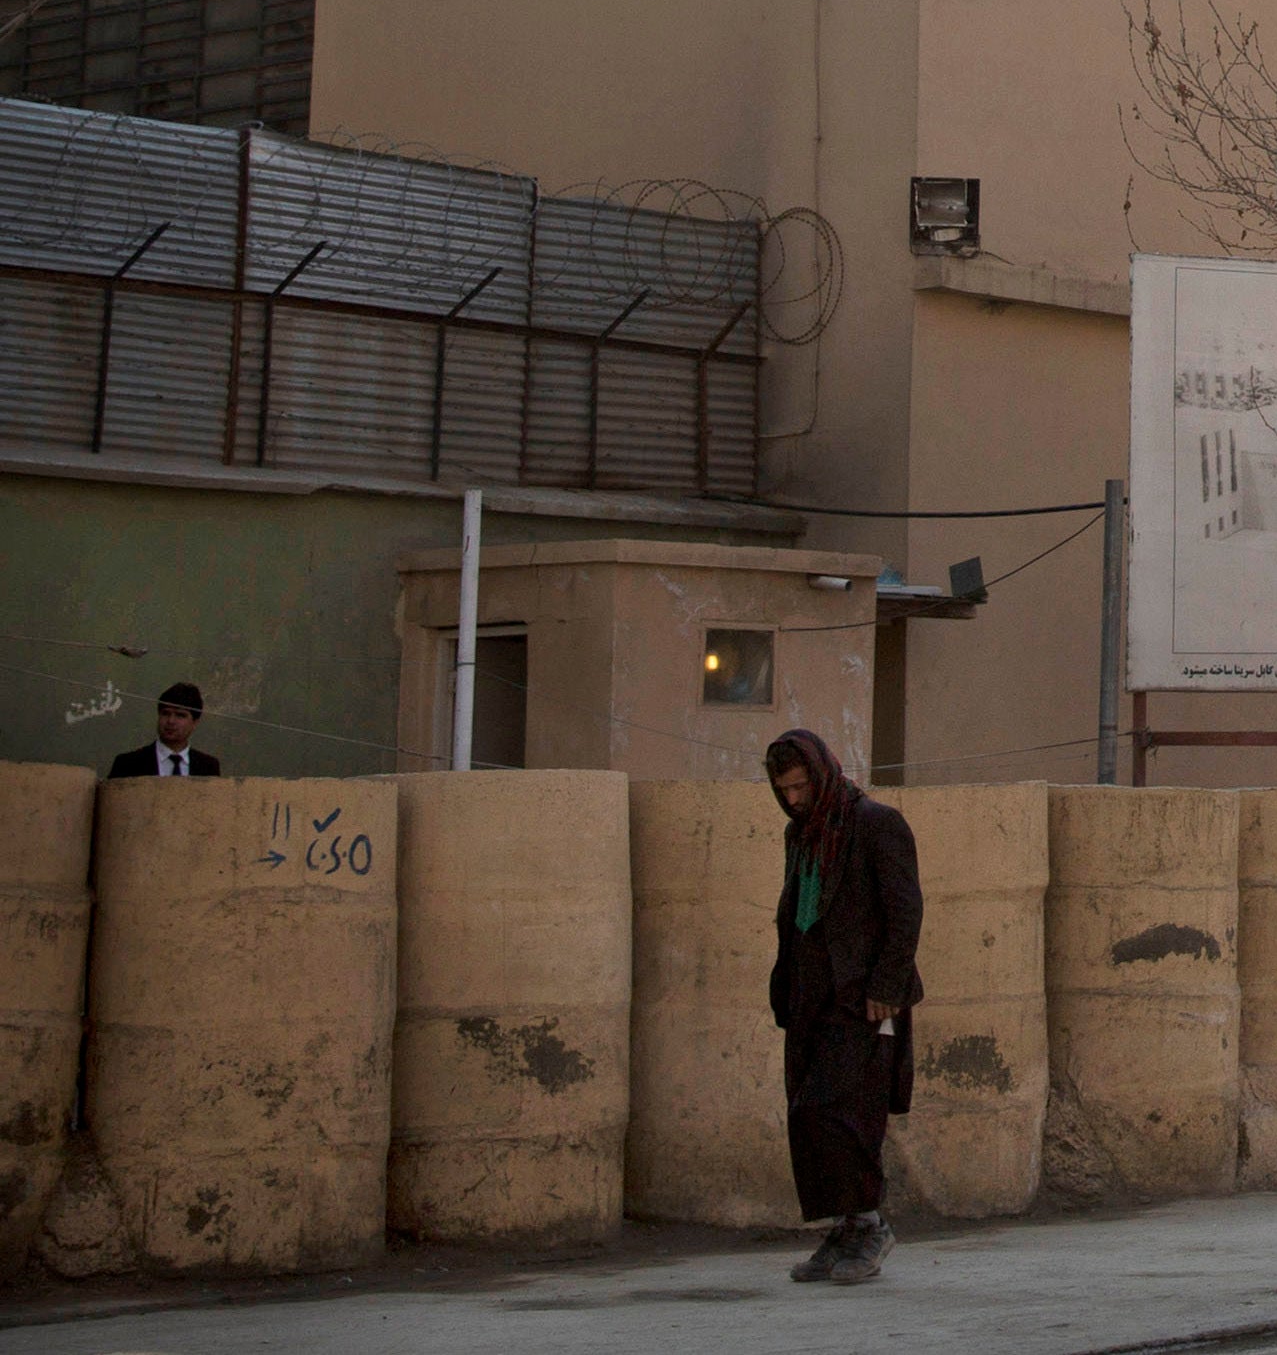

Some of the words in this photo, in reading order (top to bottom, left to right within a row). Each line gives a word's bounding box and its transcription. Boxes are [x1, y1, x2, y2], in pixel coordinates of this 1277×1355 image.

[1209, 664, 1233, 675] ساخته
[1234, 664, 1254, 678] سرینا
[1256, 664, 1273, 678] کابل
